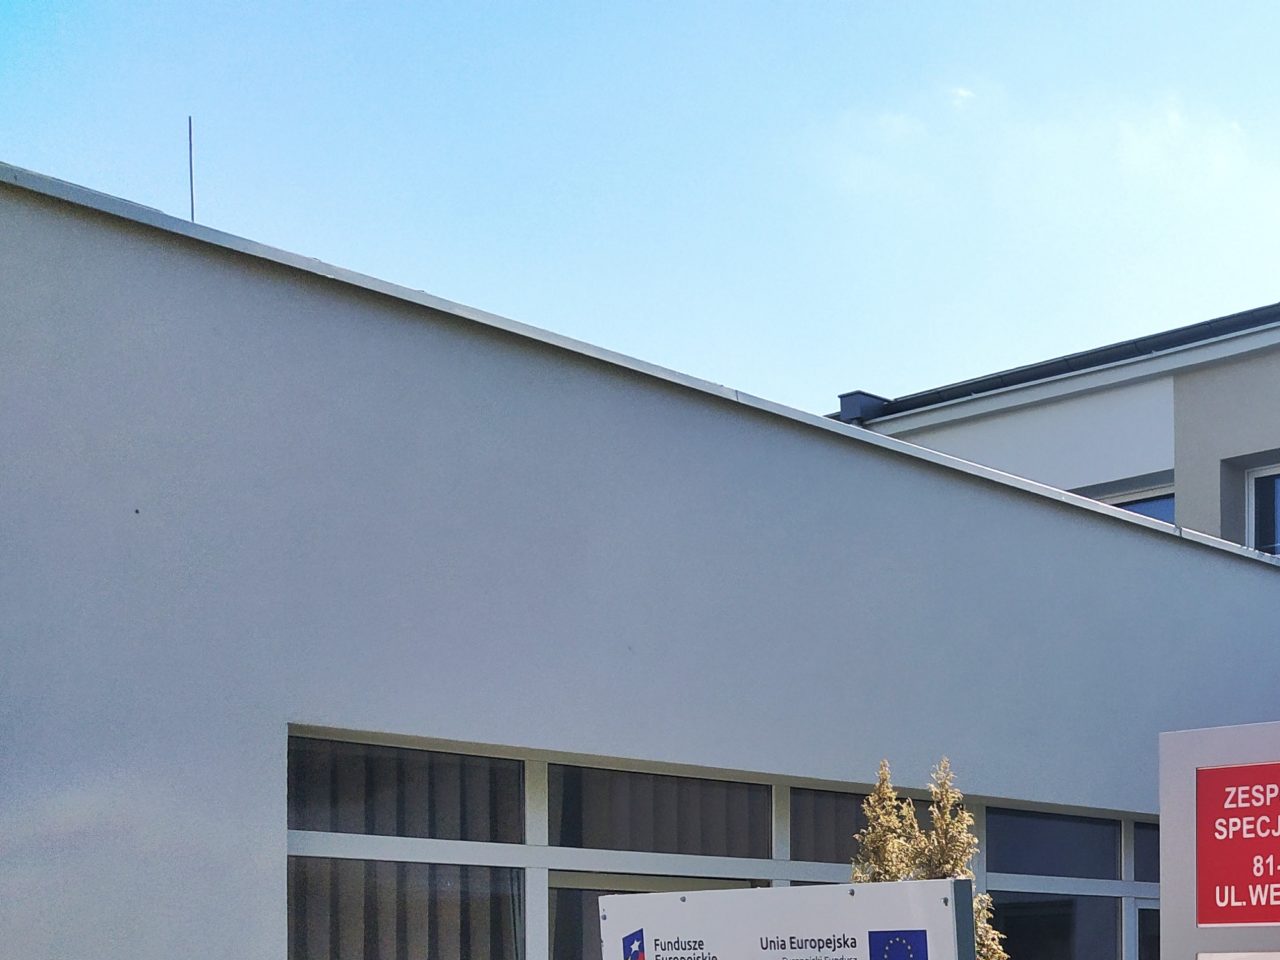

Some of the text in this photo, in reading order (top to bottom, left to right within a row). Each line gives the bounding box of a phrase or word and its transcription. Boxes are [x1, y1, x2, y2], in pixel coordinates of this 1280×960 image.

[654, 937, 704, 951] Fundusze
[760, 933, 857, 952] Unia Europejska
